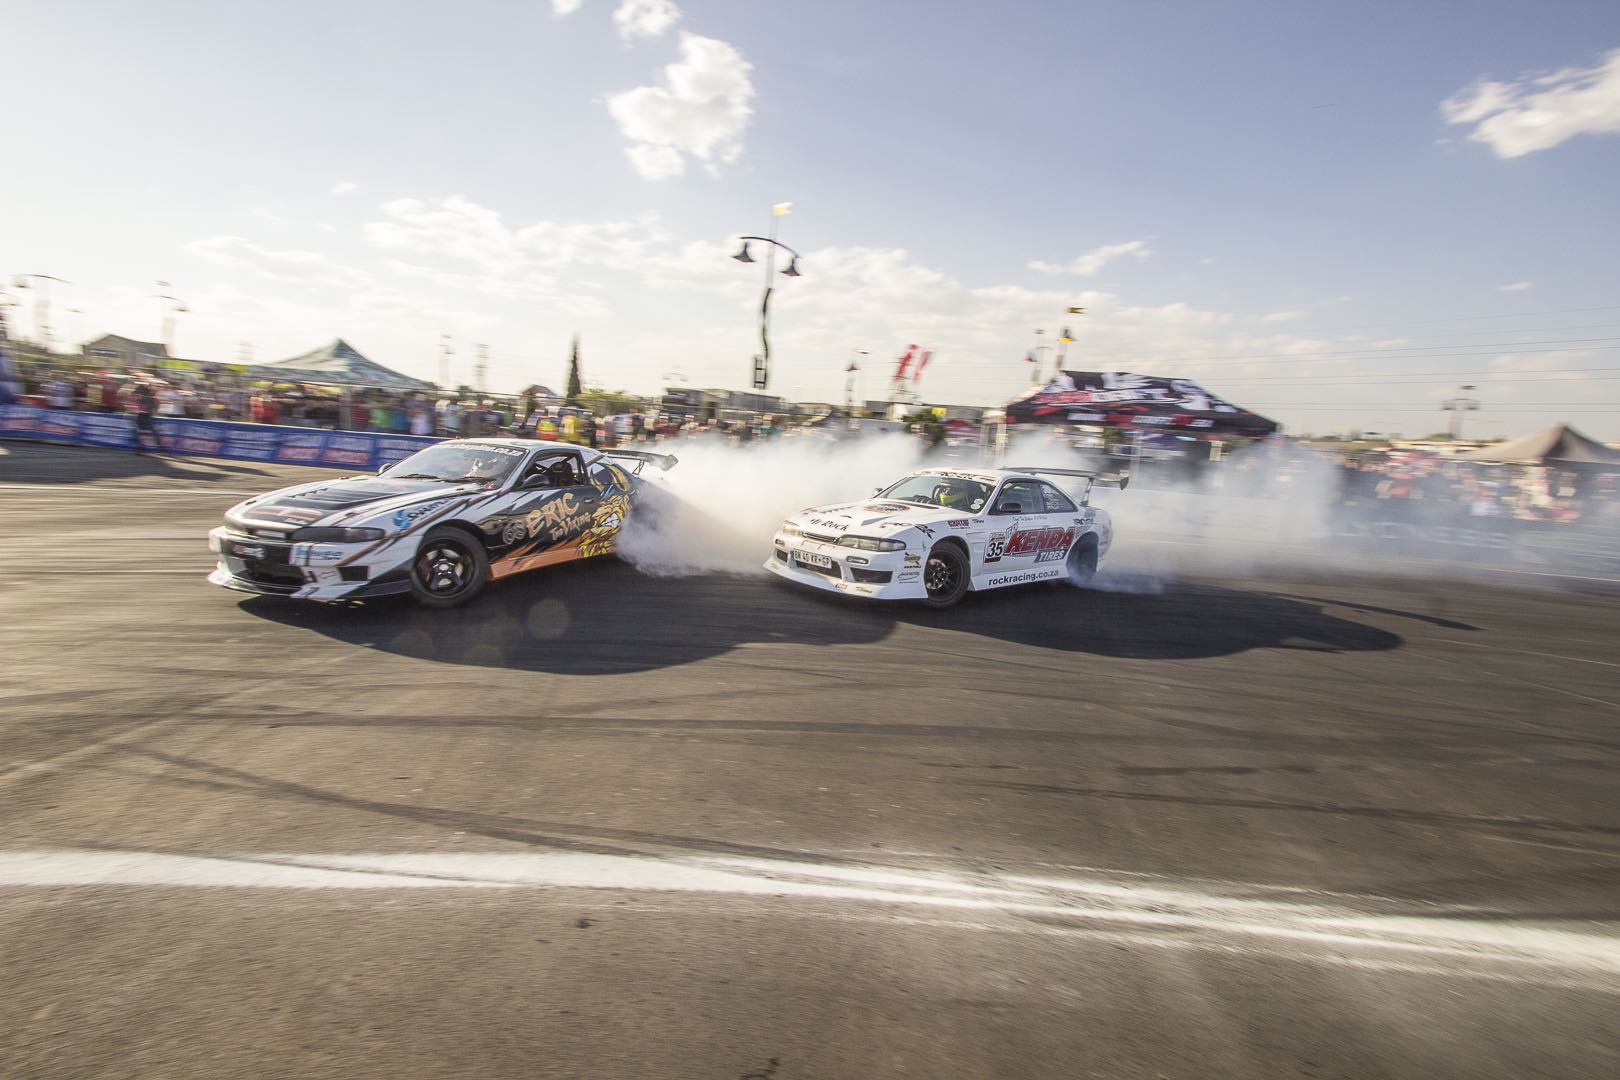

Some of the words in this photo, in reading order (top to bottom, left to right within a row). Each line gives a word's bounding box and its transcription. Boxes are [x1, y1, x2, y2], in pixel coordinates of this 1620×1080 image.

[526, 492, 579, 538] ERIC
[821, 520, 849, 531] Rock
[1005, 527, 1076, 554] KENDA
[987, 541, 1004, 557] 35
[1038, 550, 1064, 562] TIRES
[988, 569, 1059, 586] rockracing.co.za
